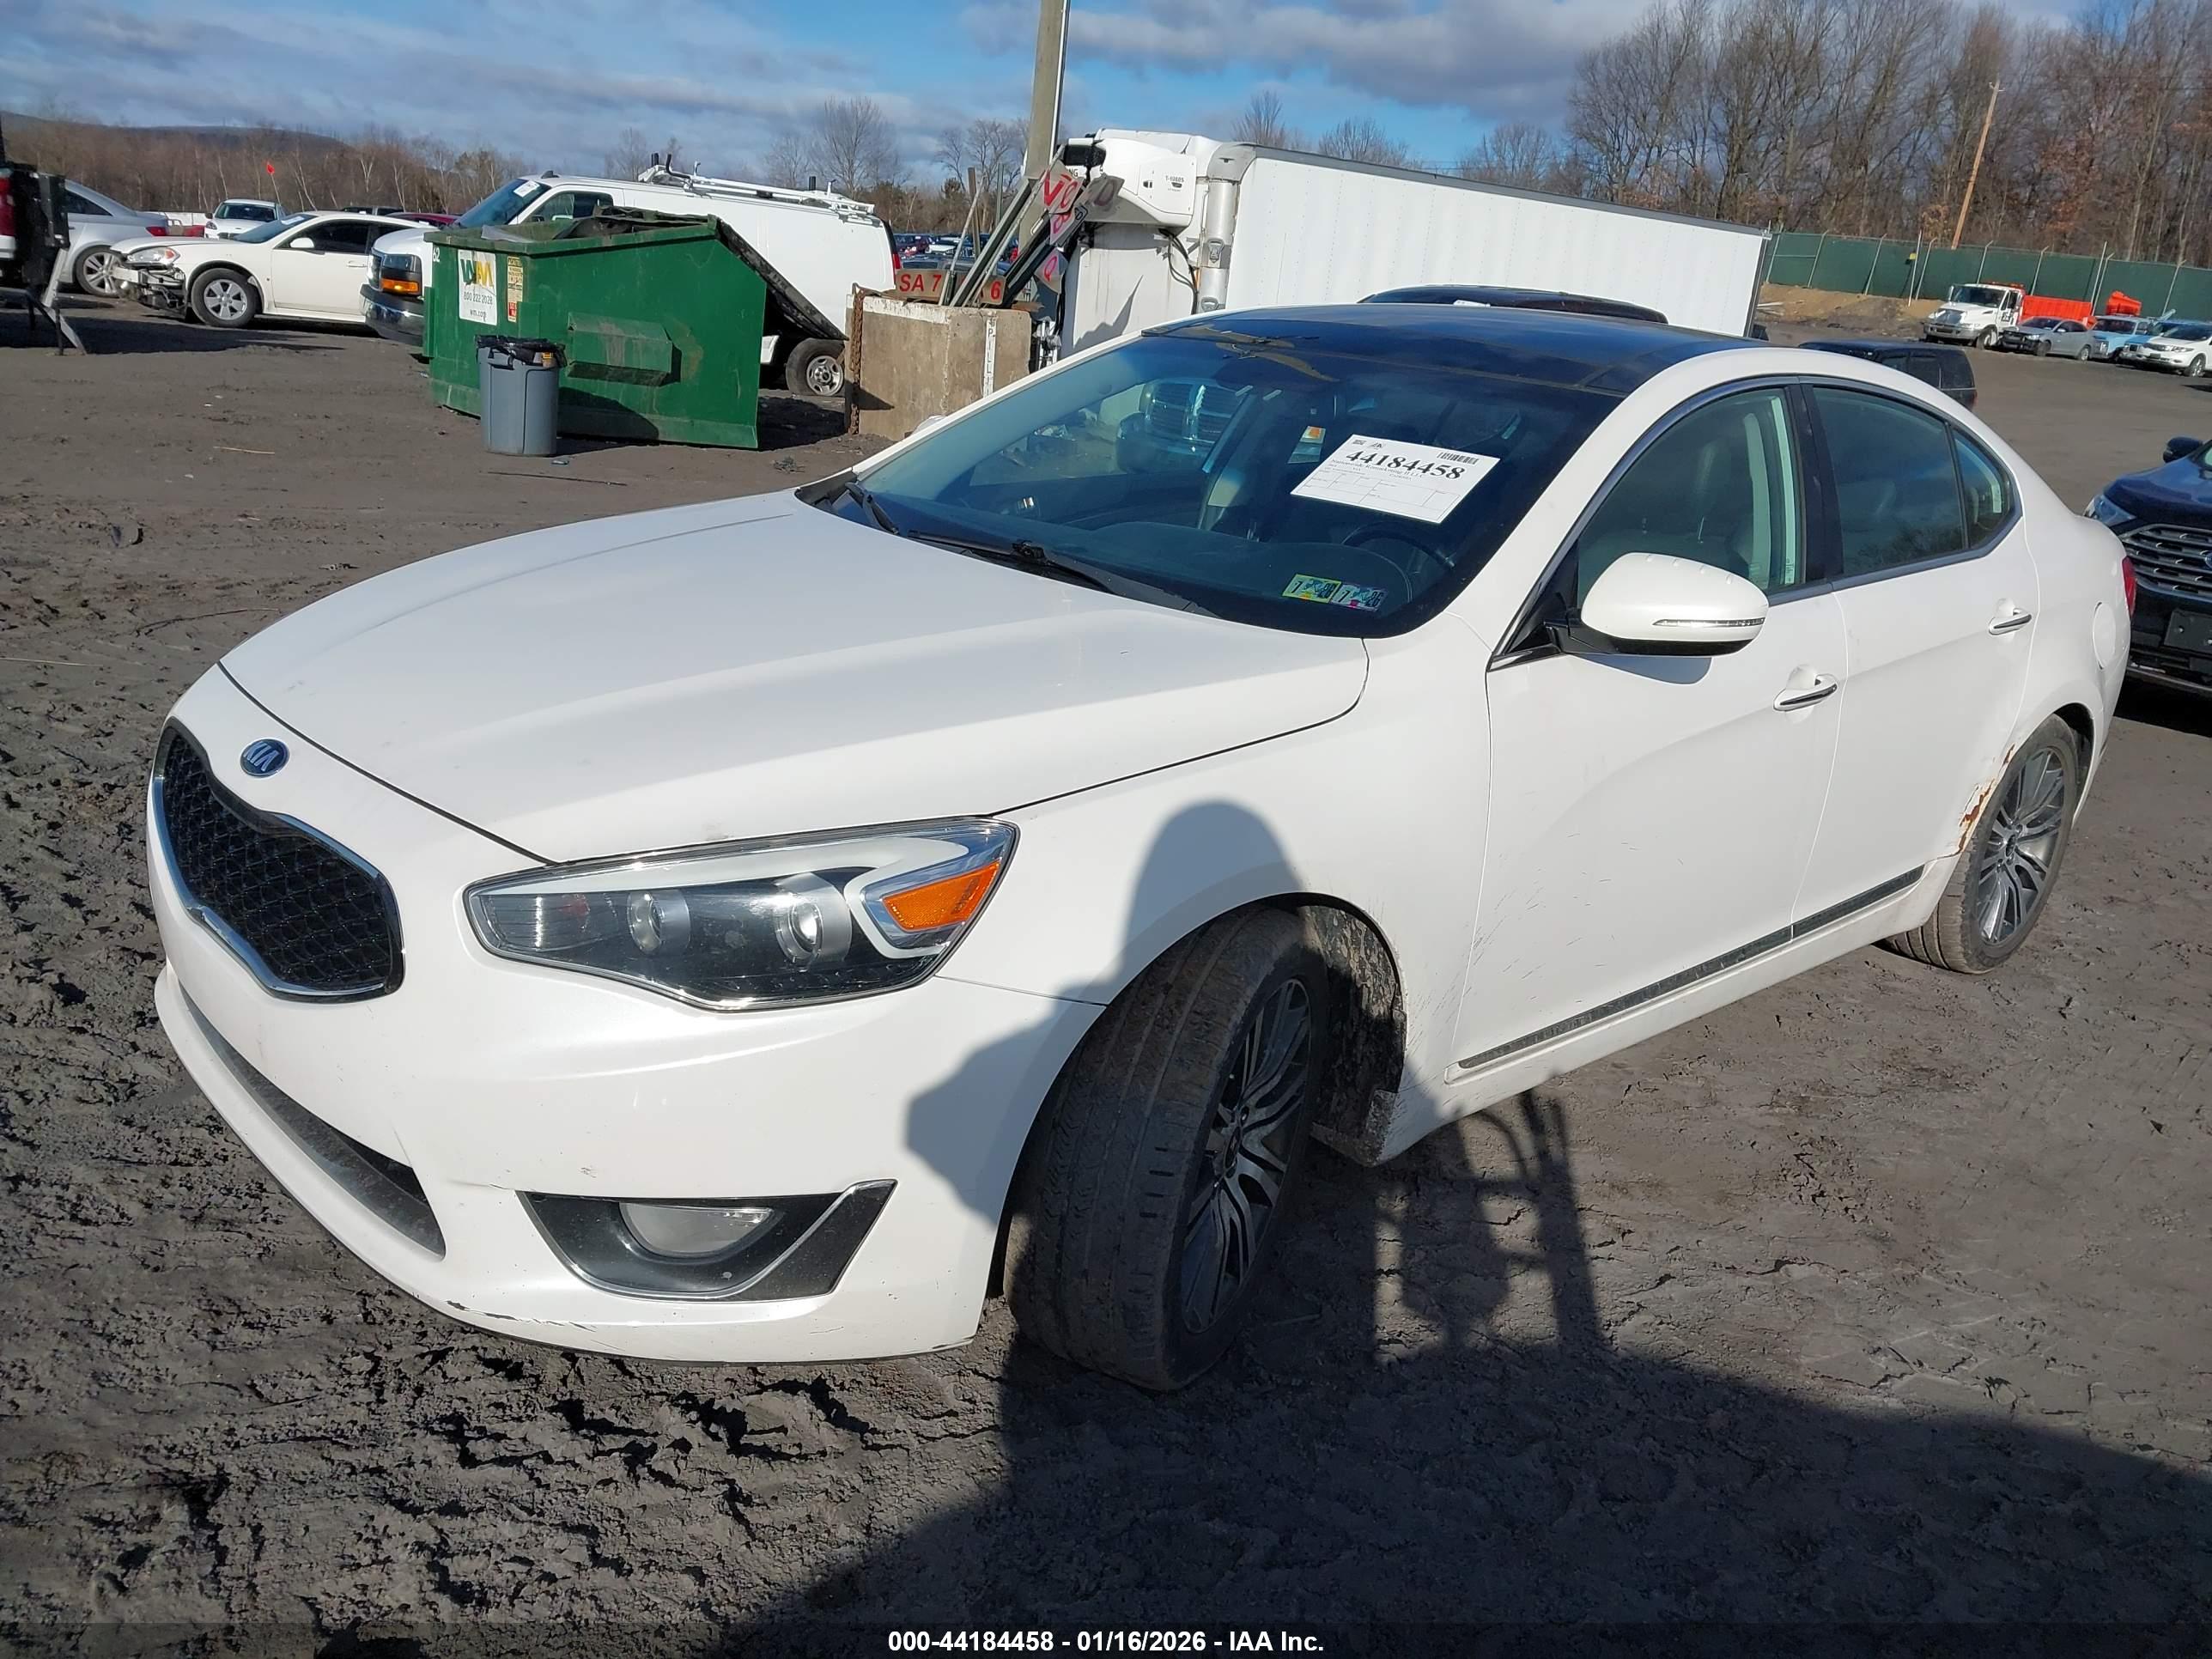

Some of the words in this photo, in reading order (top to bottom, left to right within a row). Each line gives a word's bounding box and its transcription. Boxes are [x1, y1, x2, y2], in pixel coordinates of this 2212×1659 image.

[899, 273, 924, 293] SA
[932, 274, 942, 292] 7
[990, 281, 1002, 300] 6
[1346, 450, 1467, 480] 44184458
